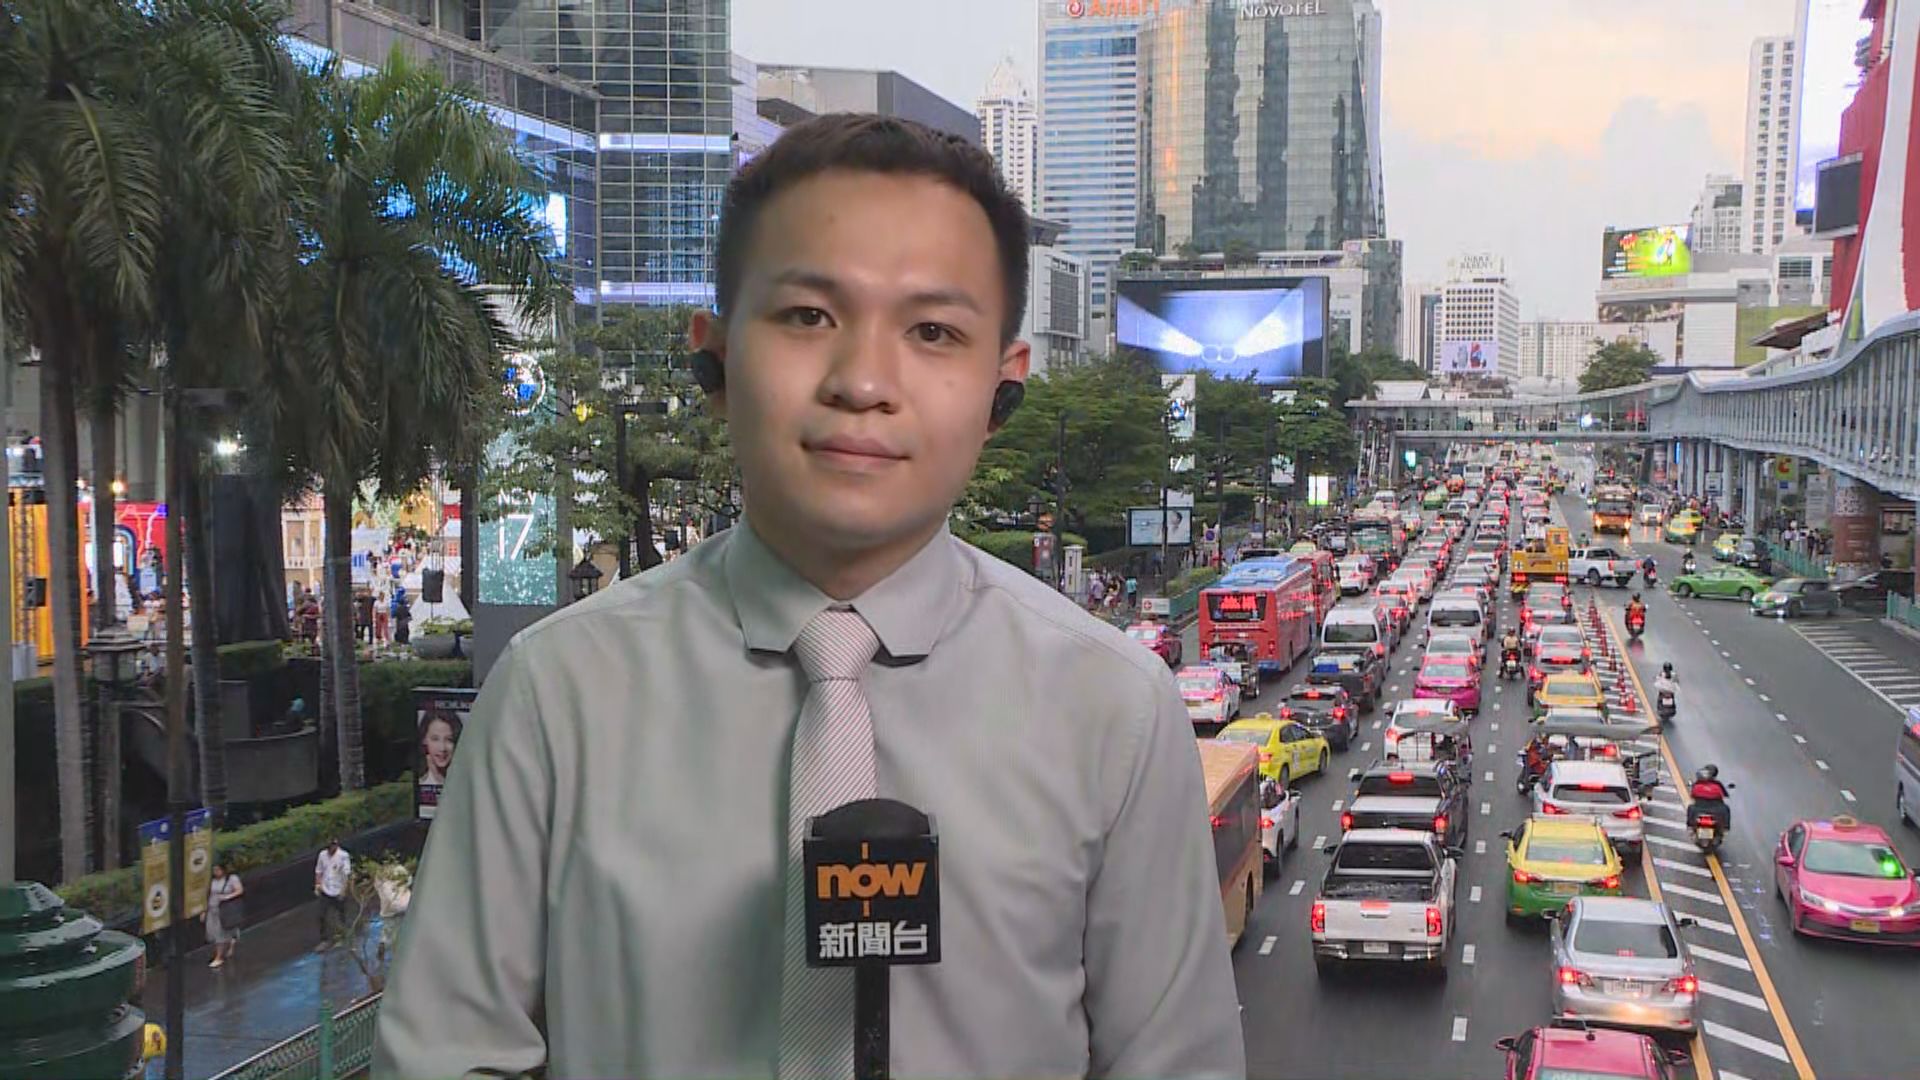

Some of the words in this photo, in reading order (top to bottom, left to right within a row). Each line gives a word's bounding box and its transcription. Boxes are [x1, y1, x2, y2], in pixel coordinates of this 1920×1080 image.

[1240, 0, 1328, 20] NOVOTEL
[816, 861, 927, 899] now
[818, 920, 927, 959] 新聞台
